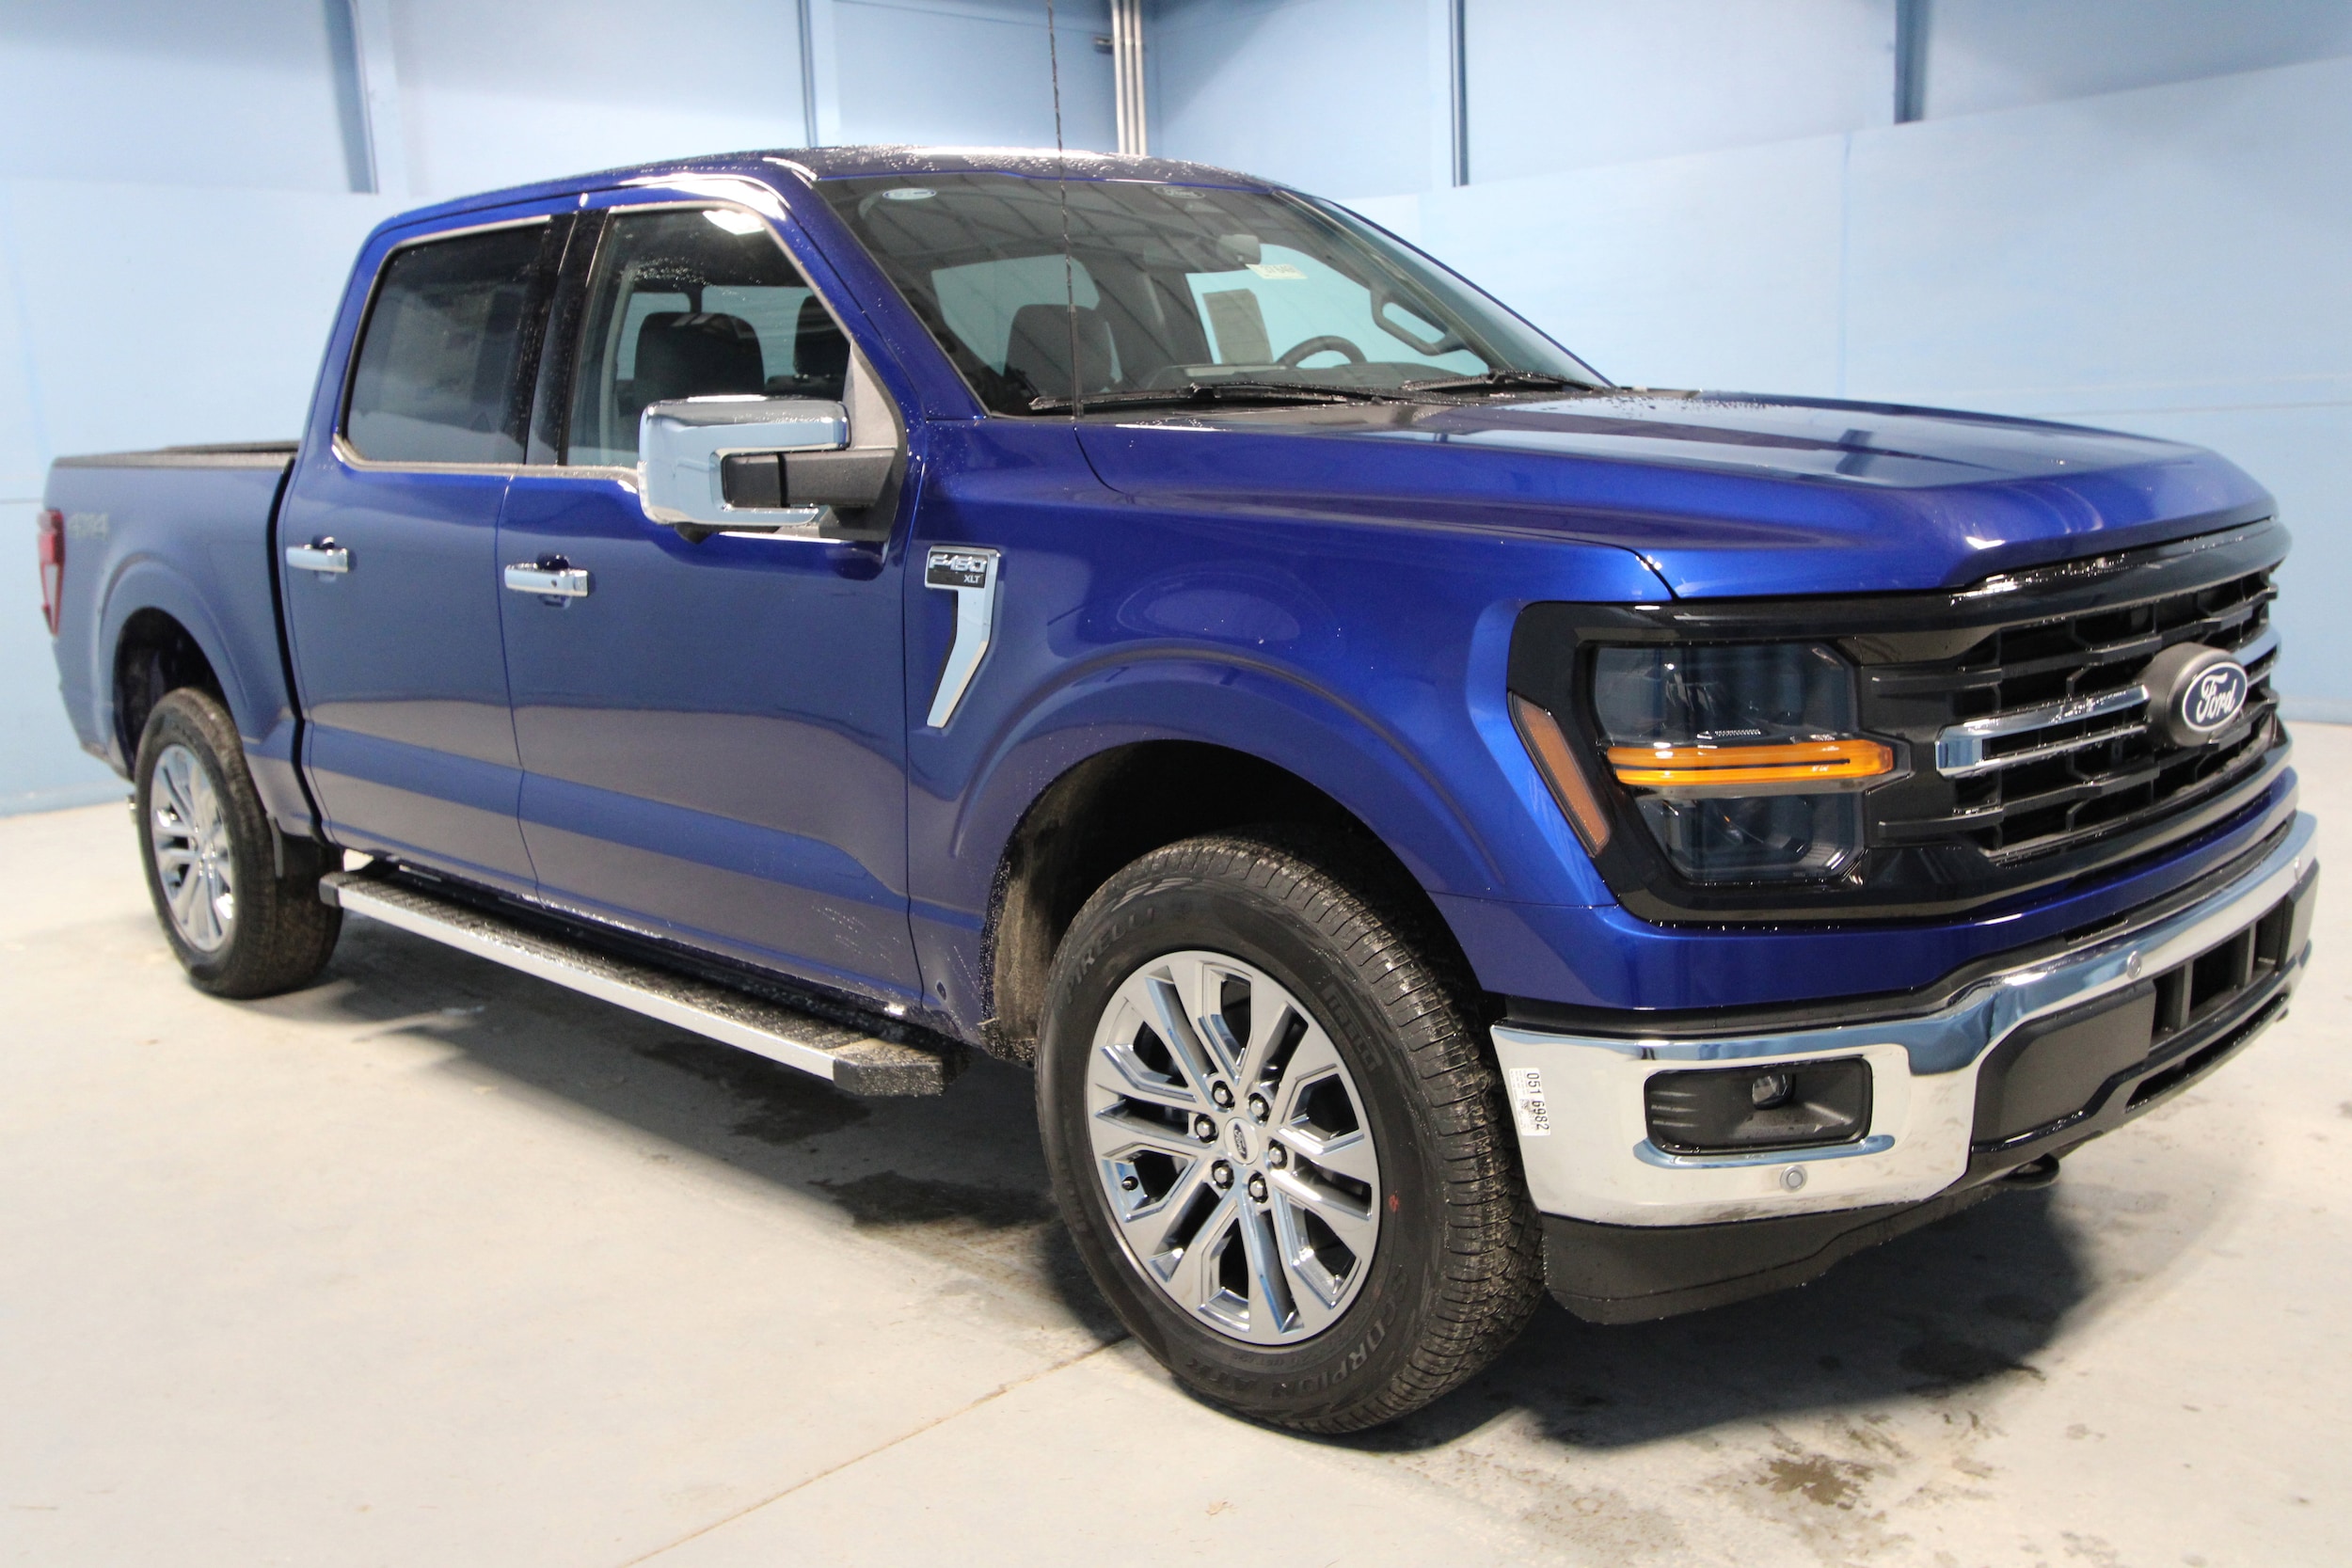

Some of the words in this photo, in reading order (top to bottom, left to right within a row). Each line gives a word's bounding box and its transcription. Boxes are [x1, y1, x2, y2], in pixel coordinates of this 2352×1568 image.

[930, 554, 987, 573] F-150
[963, 574, 980, 583] XLT
[2196, 672, 2237, 723] Ford
[1526, 1072, 1542, 1095] 051
[1532, 1100, 1549, 1131] 6982
